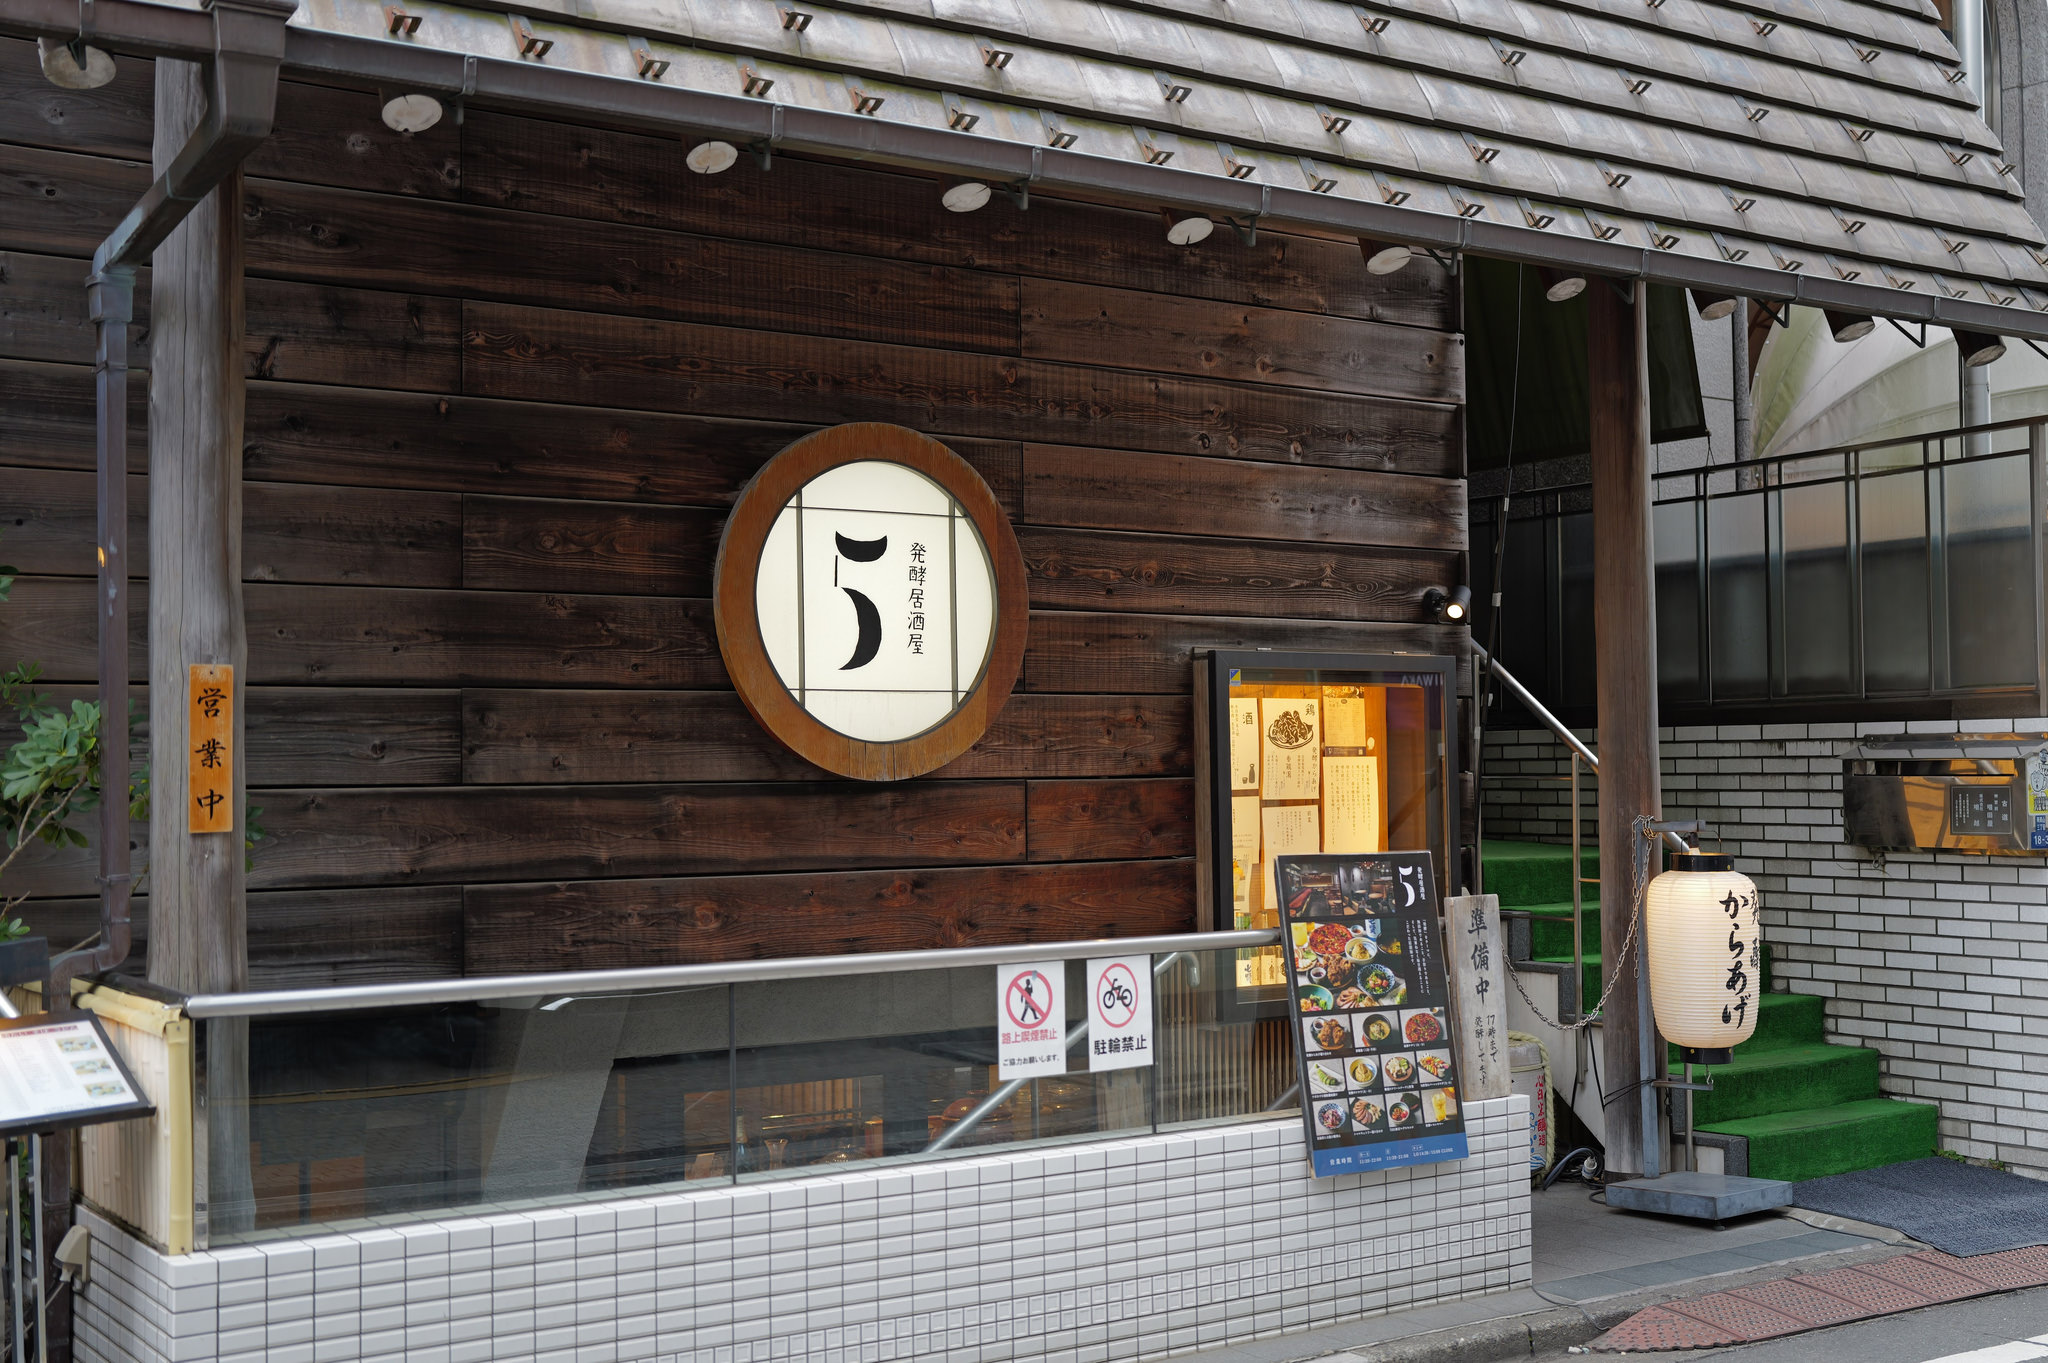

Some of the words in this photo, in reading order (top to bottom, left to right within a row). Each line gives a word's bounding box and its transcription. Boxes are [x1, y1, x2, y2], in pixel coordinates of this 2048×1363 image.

[835, 531, 887, 670] 5
[908, 543, 927, 655] 発酵居酒屋
[1242, 712, 1253, 725] 酒
[1305, 703, 1315, 716] 鶏
[195, 687, 227, 820] 営業中
[1398, 865, 1416, 907] 5
[1468, 907, 1490, 1005] 準備中
[1719, 889, 1751, 1029] からあげ
[1001, 1028, 1058, 1045] 路上喫煙禁止
[1094, 1034, 1147, 1056] 駐輪禁止
[1002, 1054, 1060, 1067] ご協力お願いします。
